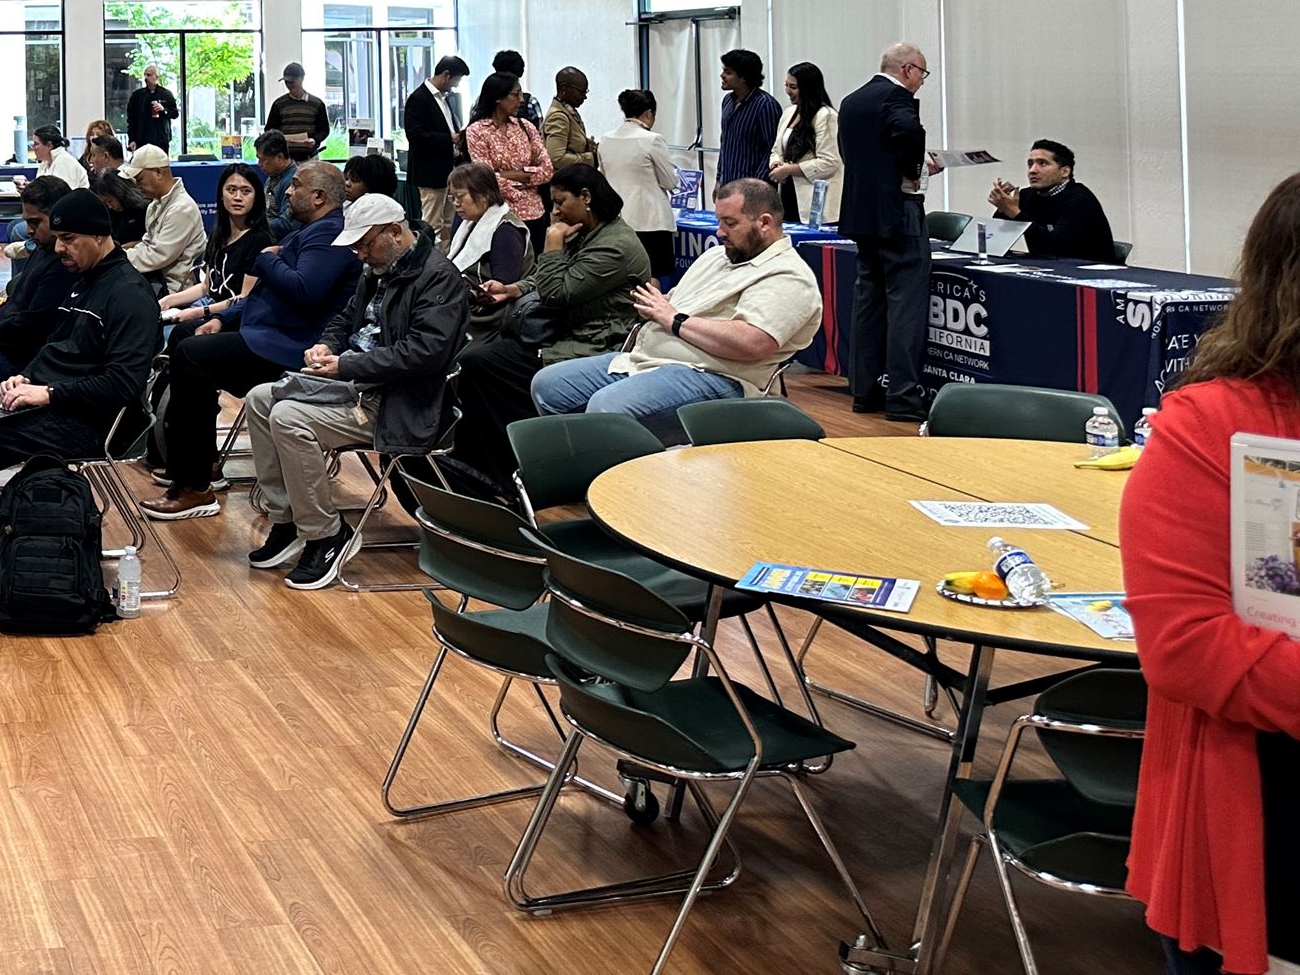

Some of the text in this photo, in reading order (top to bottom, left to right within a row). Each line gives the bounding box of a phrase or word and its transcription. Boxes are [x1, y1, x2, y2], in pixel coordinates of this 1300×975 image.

[928, 294, 989, 338] BDC
[943, 350, 953, 360] CA
[954, 353, 990, 371] NETWORK
[922, 364, 976, 384] SANTA CLARA
[1246, 606, 1296, 628] Creating
